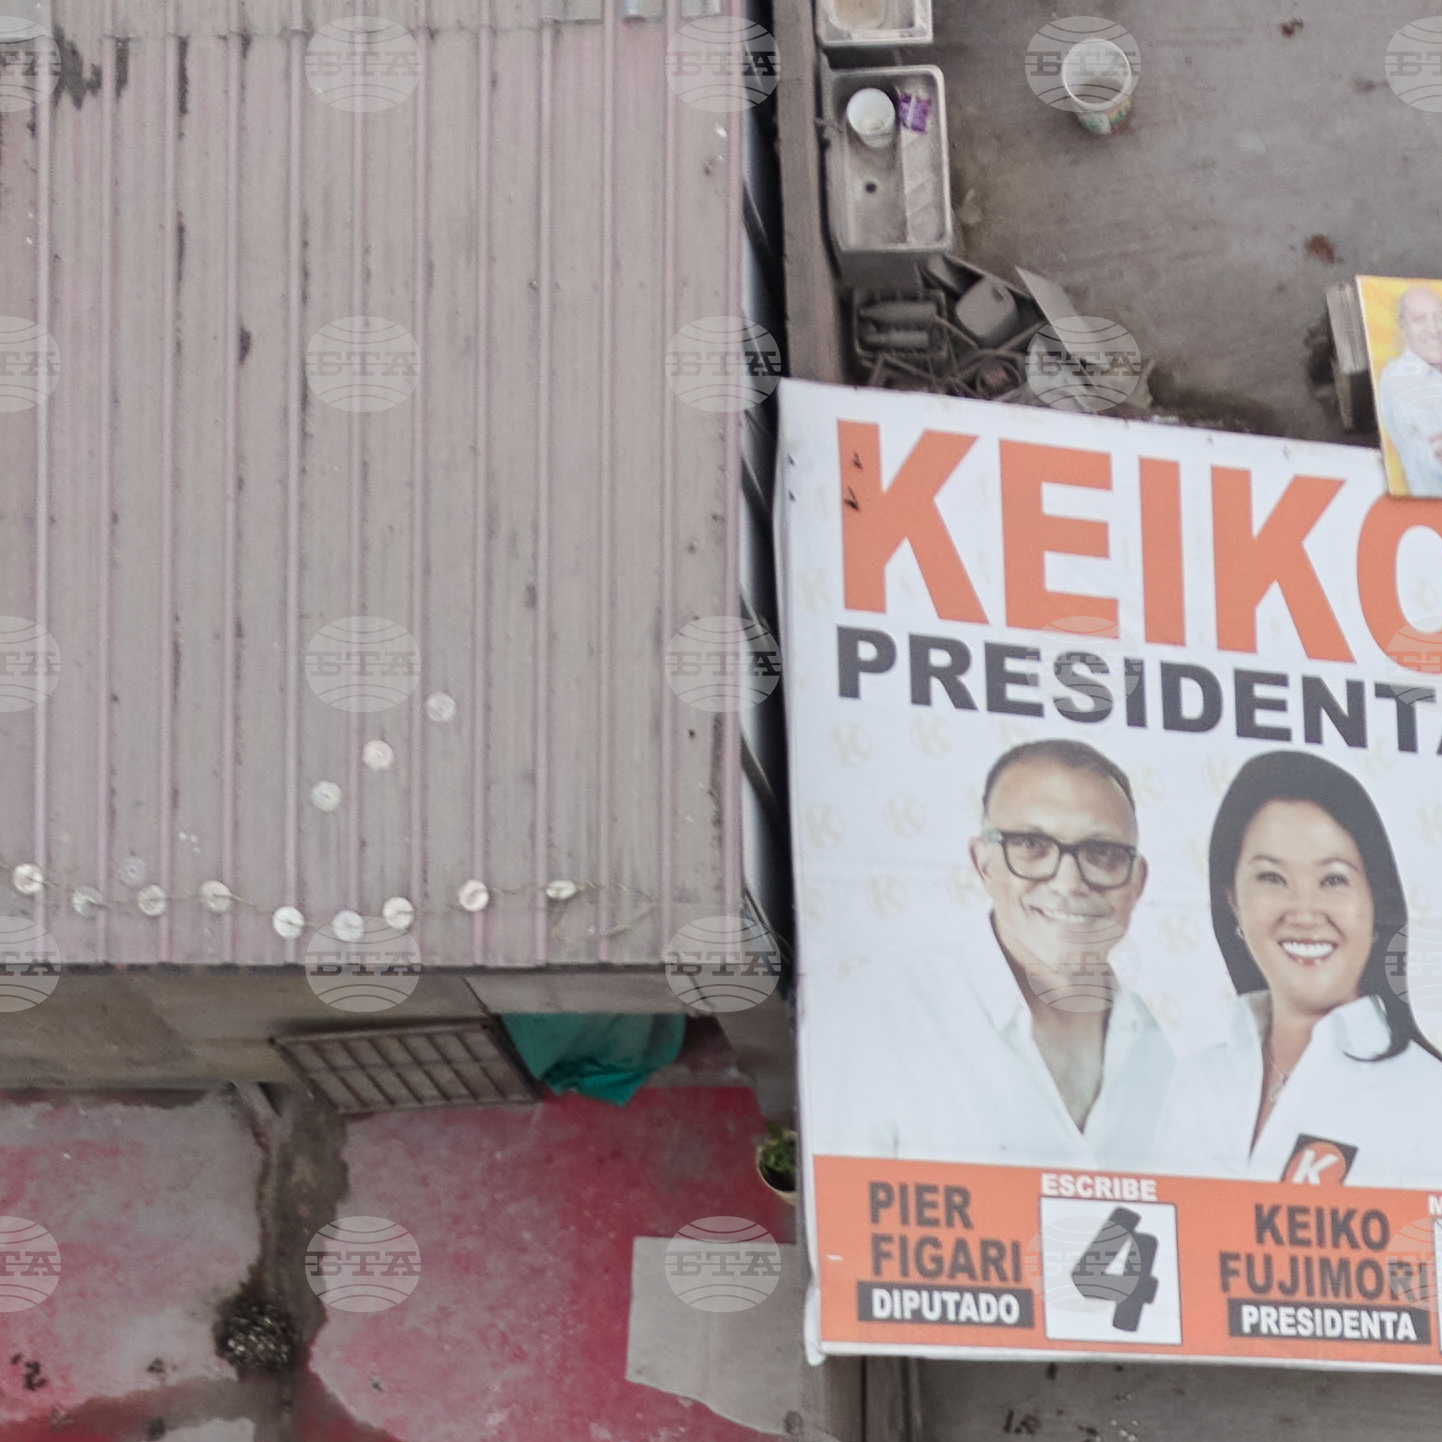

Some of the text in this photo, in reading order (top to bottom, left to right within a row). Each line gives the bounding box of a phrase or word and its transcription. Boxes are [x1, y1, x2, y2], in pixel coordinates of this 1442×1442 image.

[1040, 1172, 1158, 1202] ESCRIBE
[1291, 1149, 1339, 1186] K
[868, 1180, 974, 1230] PIER
[1254, 1203, 1390, 1251] KEIKO
[870, 1232, 1024, 1284] FIGARI
[1071, 1206, 1160, 1333] 4
[1219, 1251, 1429, 1303] FUJIMORI
[871, 1287, 1021, 1325] DIPUTADO
[1241, 1305, 1418, 1341] PRESIDENTA
